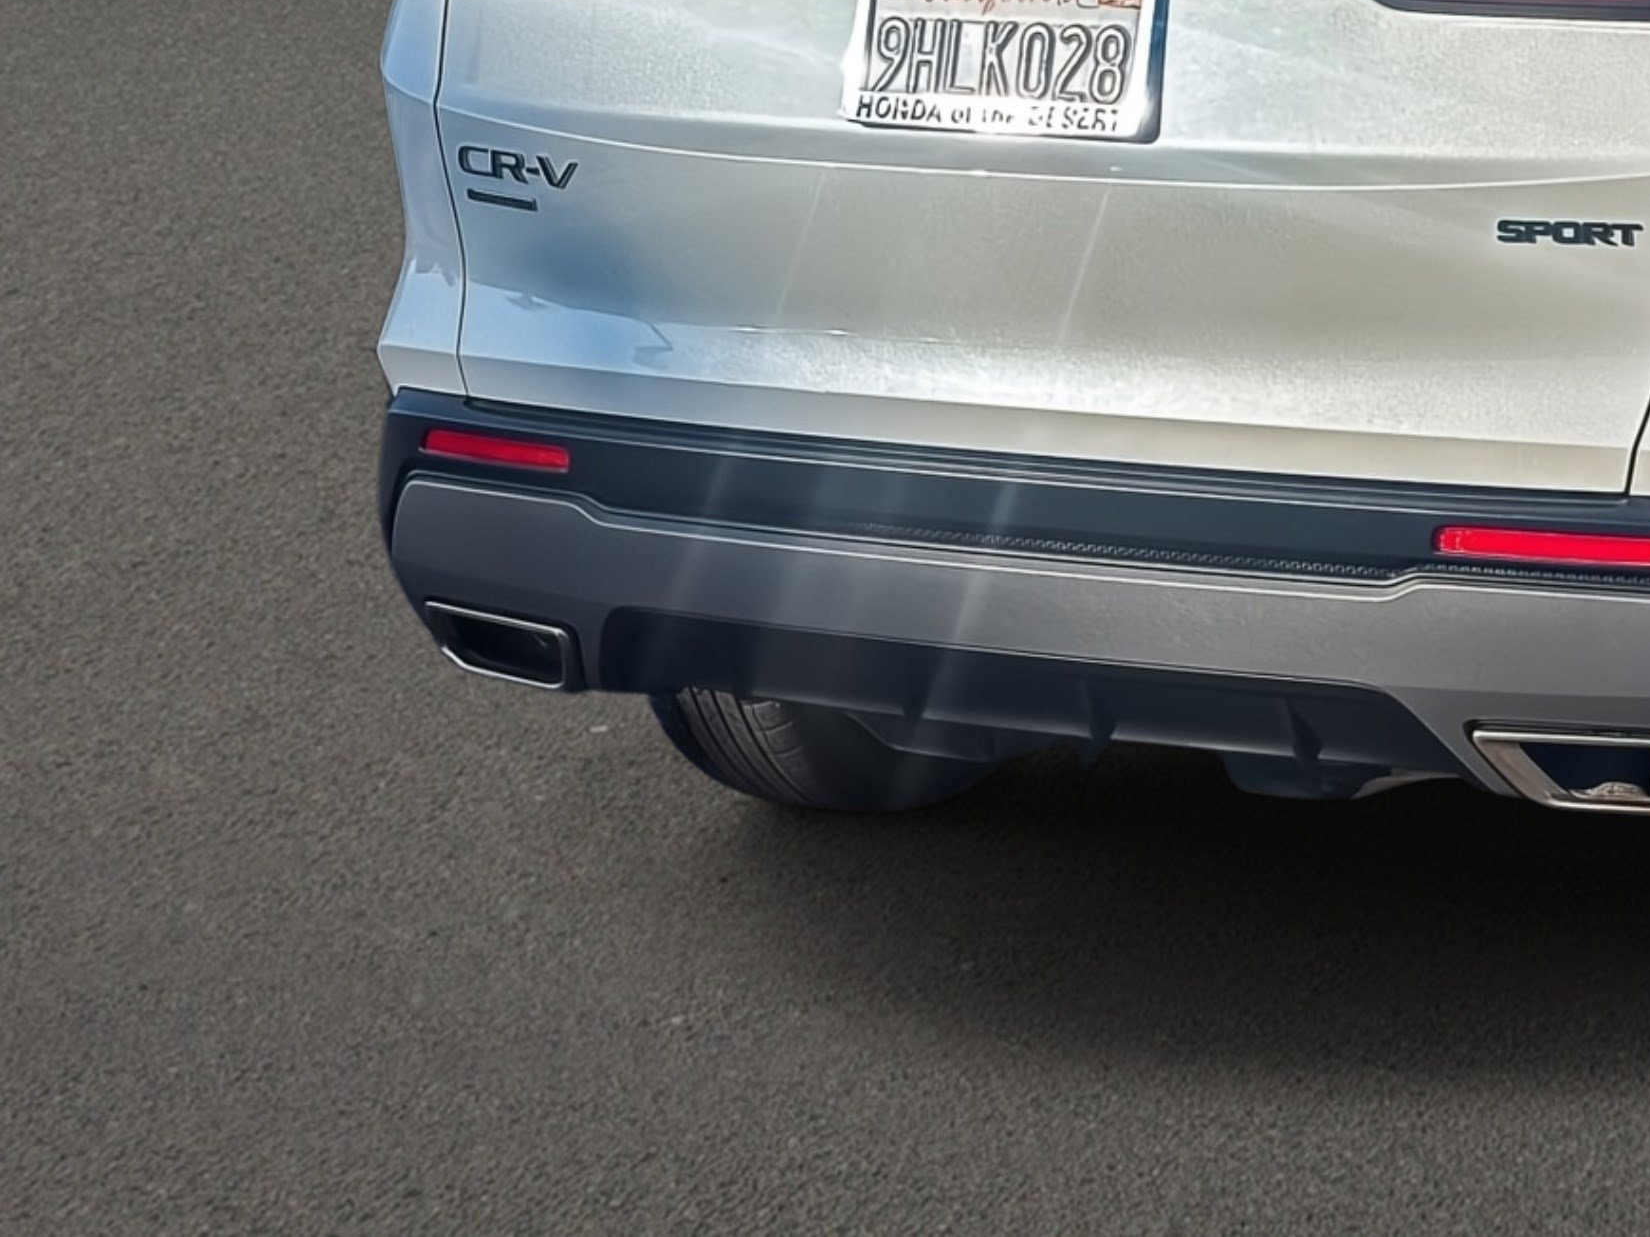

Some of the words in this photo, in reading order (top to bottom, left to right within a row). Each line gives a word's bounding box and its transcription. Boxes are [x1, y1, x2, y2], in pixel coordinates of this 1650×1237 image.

[873, 15, 1133, 105] 9HLK028
[857, 94, 942, 123] HONDA
[458, 145, 579, 189] CR-V
[1496, 219, 1644, 247] SPORT
